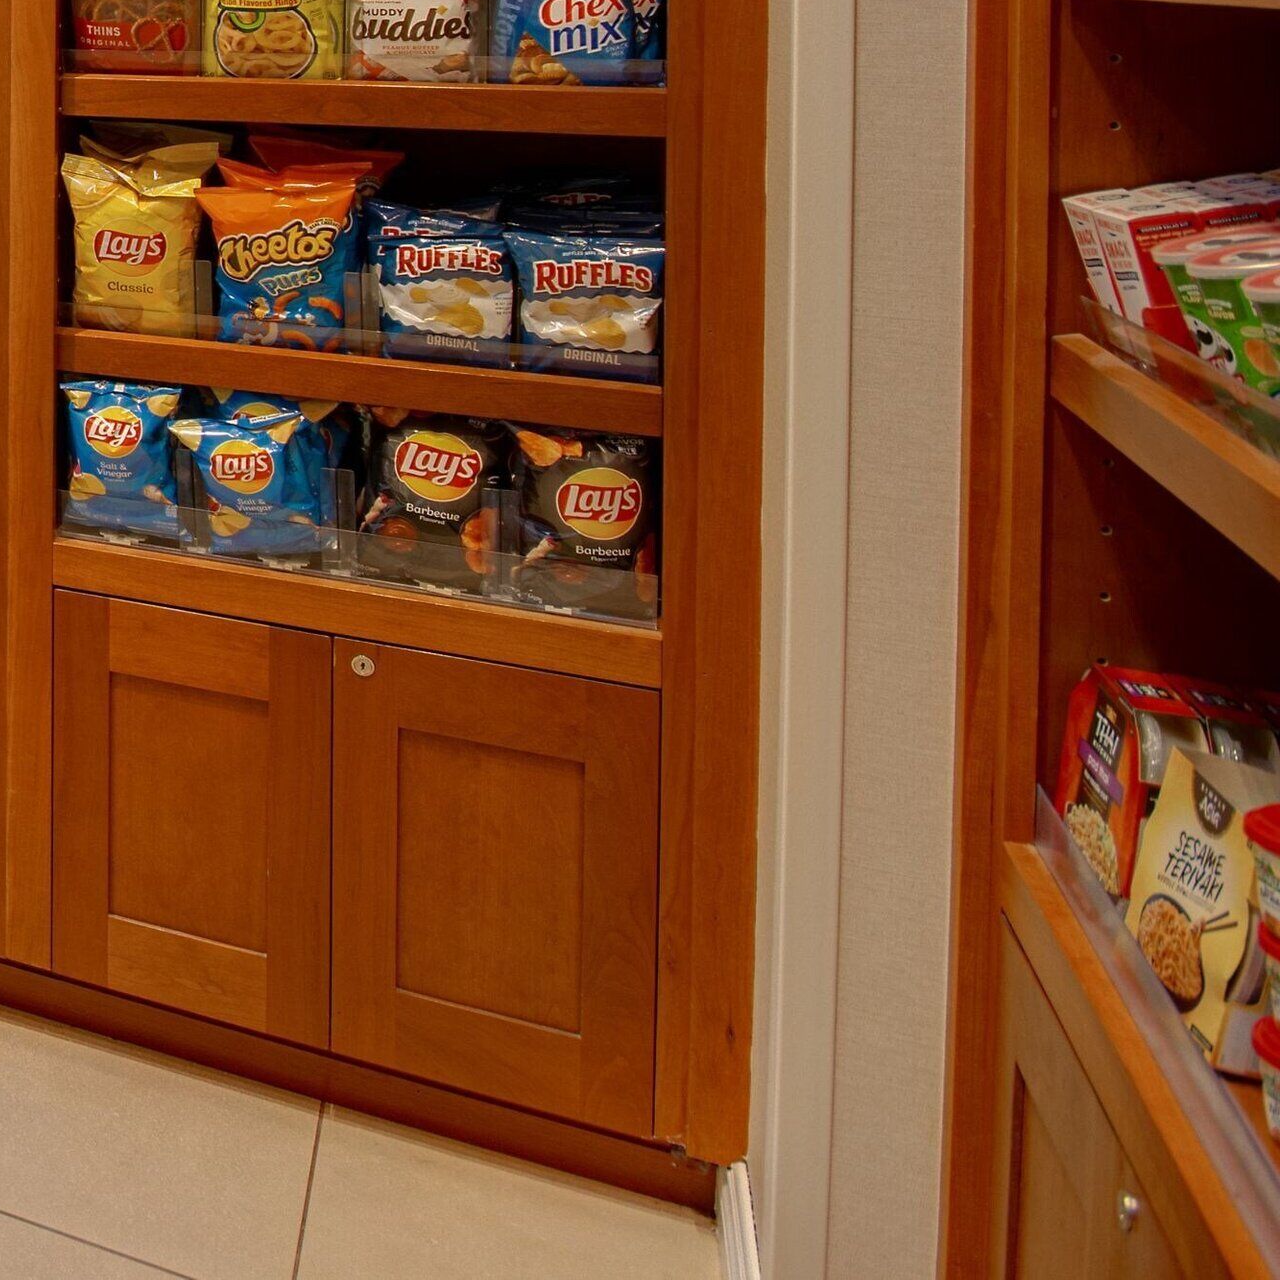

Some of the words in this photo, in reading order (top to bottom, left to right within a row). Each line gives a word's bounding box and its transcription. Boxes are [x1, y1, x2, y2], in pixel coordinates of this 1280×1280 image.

[362, 8, 404, 17] MUDDY
[80, 37, 131, 48] ORIGINAL
[87, 24, 121, 37] THINS
[551, 16, 627, 57] mix
[97, 229, 164, 266] Lay's
[219, 223, 333, 280] Cheetos
[396, 244, 504, 277] RUFFLES
[107, 280, 154, 295] Classic
[260, 268, 321, 295] PUFFS
[534, 259, 653, 295] RUFFLES
[426, 333, 481, 353] ORIGINAL
[563, 348, 622, 367] ORIGINAL
[88, 417, 139, 447] Lay's
[96, 468, 133, 479] Vinegar
[99, 461, 119, 471] Salt
[214, 452, 269, 482] Lay's
[400, 441, 477, 487] Lay's
[236, 497, 256, 507] Salt
[236, 504, 274, 515] Vinegar
[406, 501, 461, 523] Barbecue
[563, 483, 639, 524] Lay's
[575, 543, 632, 558] Barbecue
[1095, 711, 1120, 754] THAI
[1175, 830, 1227, 876] SESAME
[1163, 852, 1224, 903] TERIYAKI
